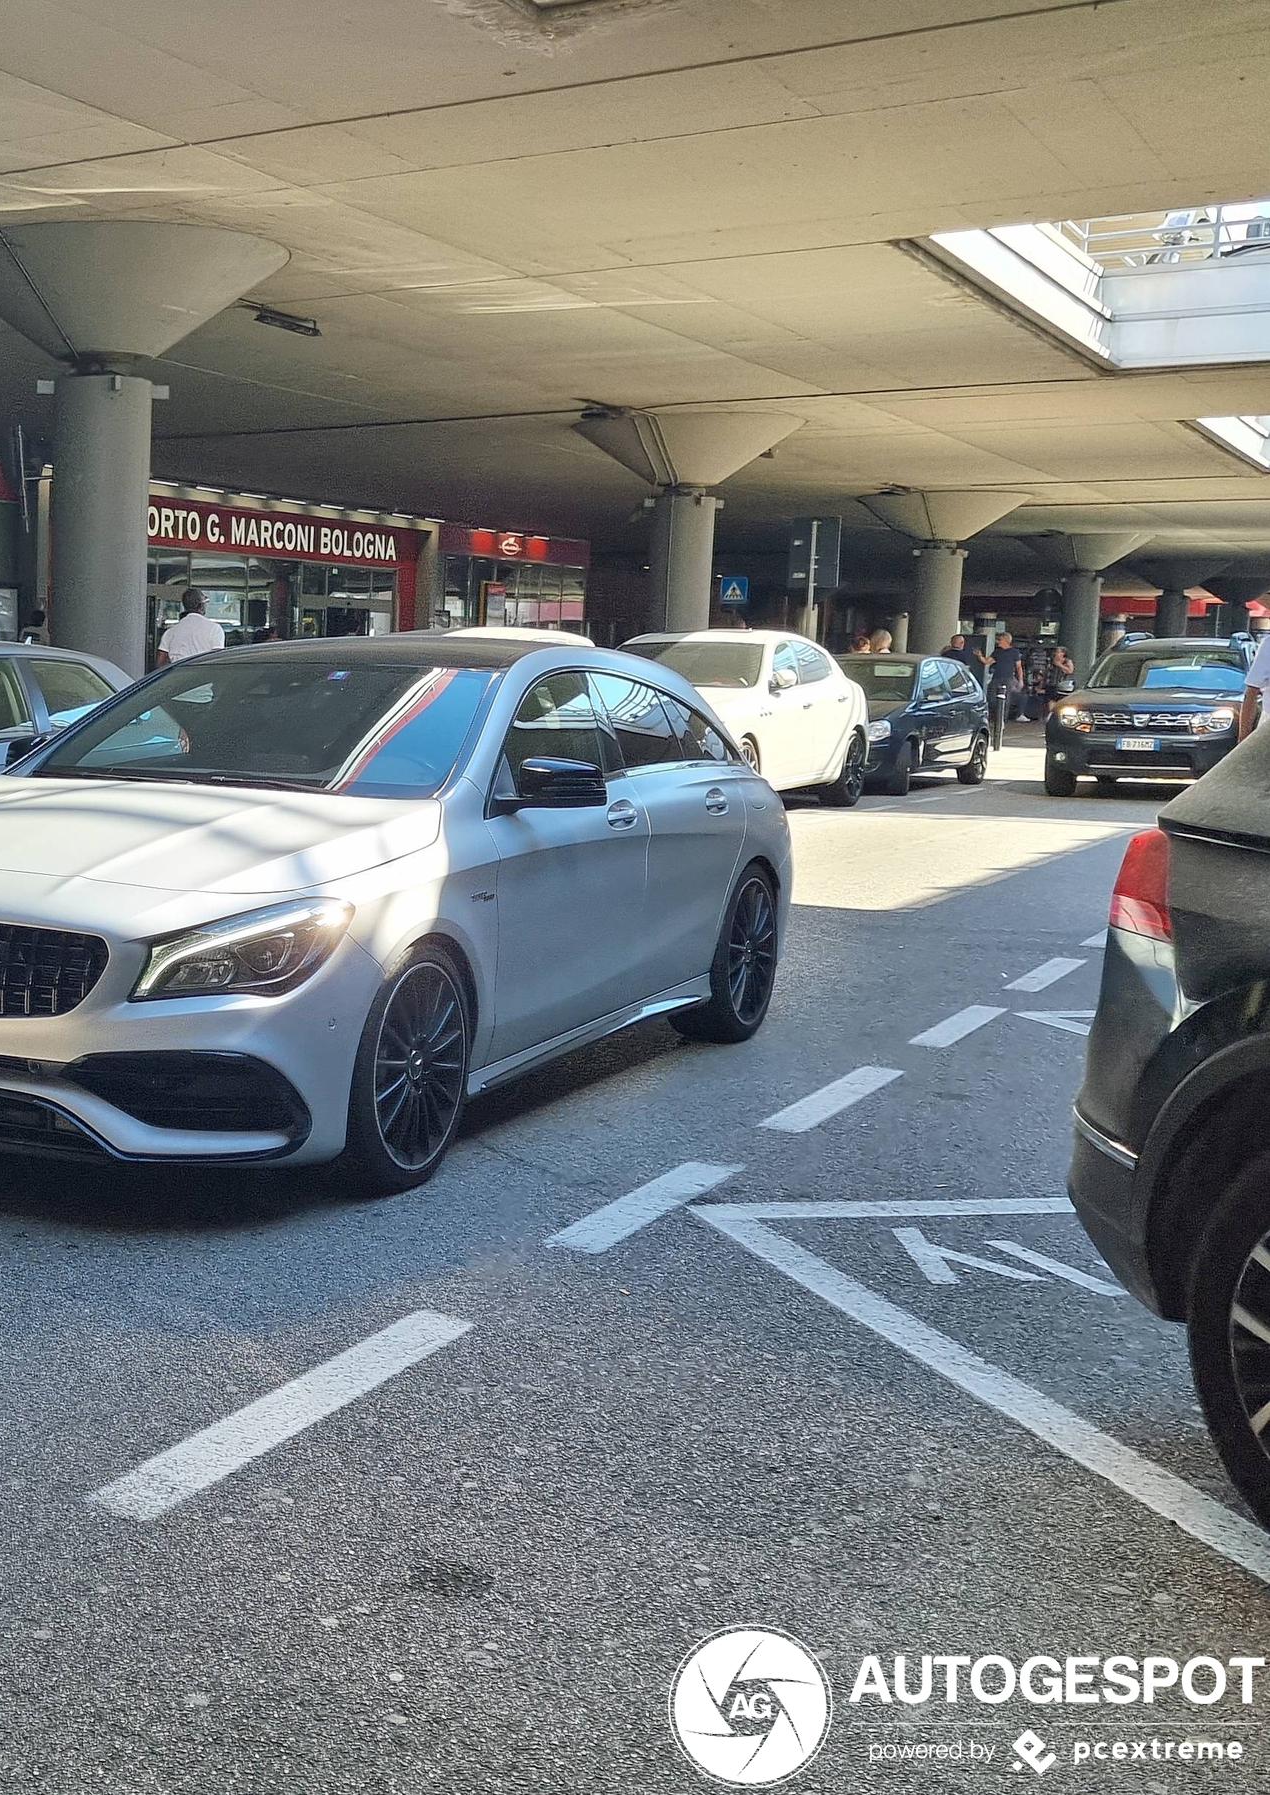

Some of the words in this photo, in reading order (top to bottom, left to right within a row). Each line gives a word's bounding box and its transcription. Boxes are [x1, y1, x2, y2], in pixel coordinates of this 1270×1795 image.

[207, 513, 225, 544] G.
[231, 516, 315, 553] MARCONI
[320, 527, 397, 561] BOLOGNA
